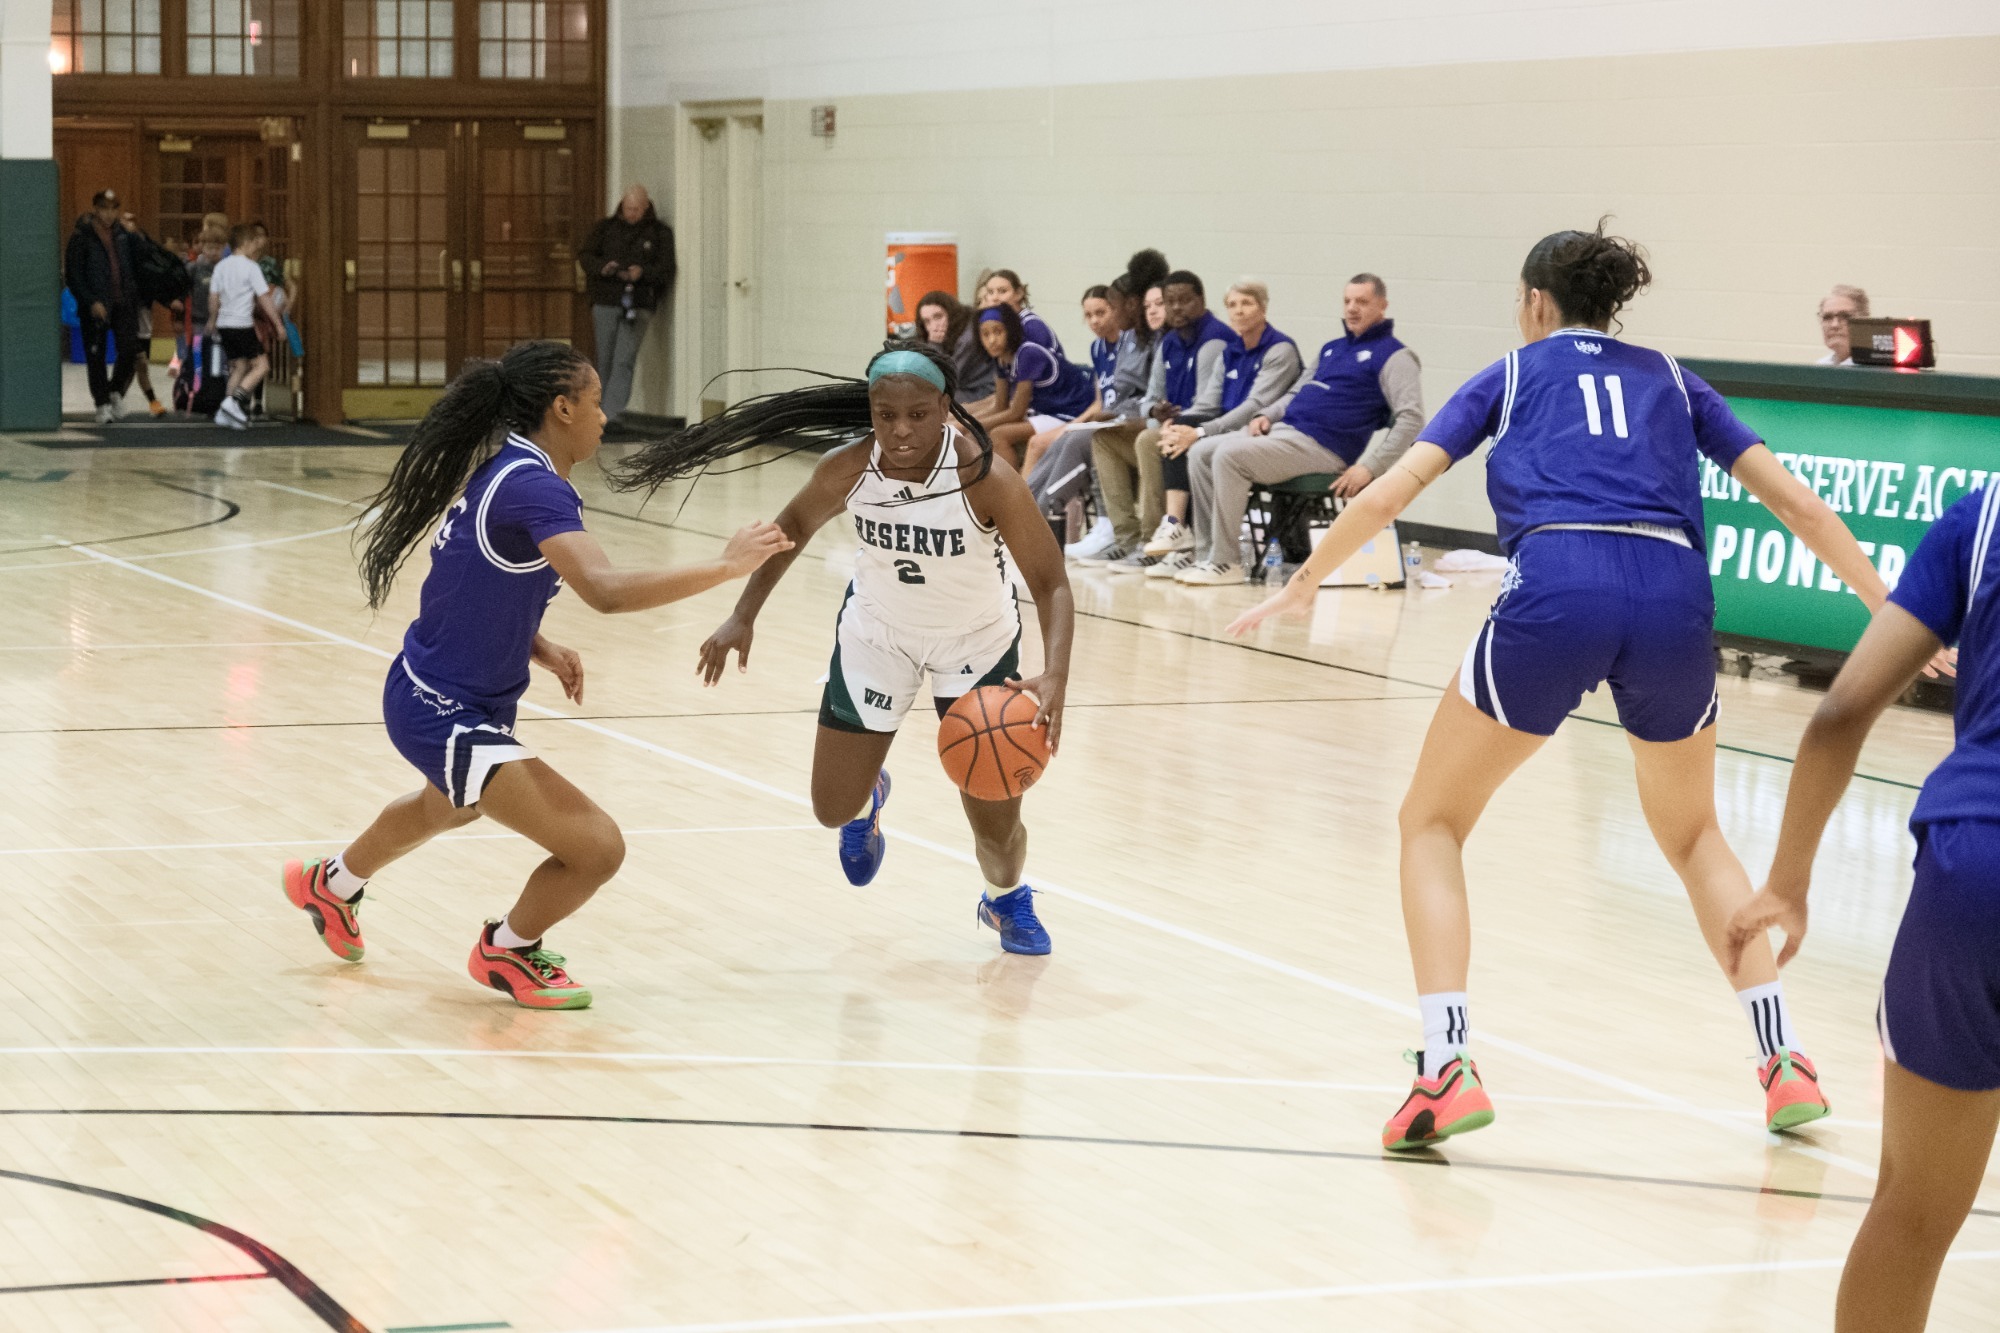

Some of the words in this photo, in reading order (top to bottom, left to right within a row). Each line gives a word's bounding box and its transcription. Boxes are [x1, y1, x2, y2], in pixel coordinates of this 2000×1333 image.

[1578, 374, 1629, 438] 11
[855, 514, 965, 557] RESERVE
[894, 559, 925, 584] 2
[864, 687, 892, 711] WRA
